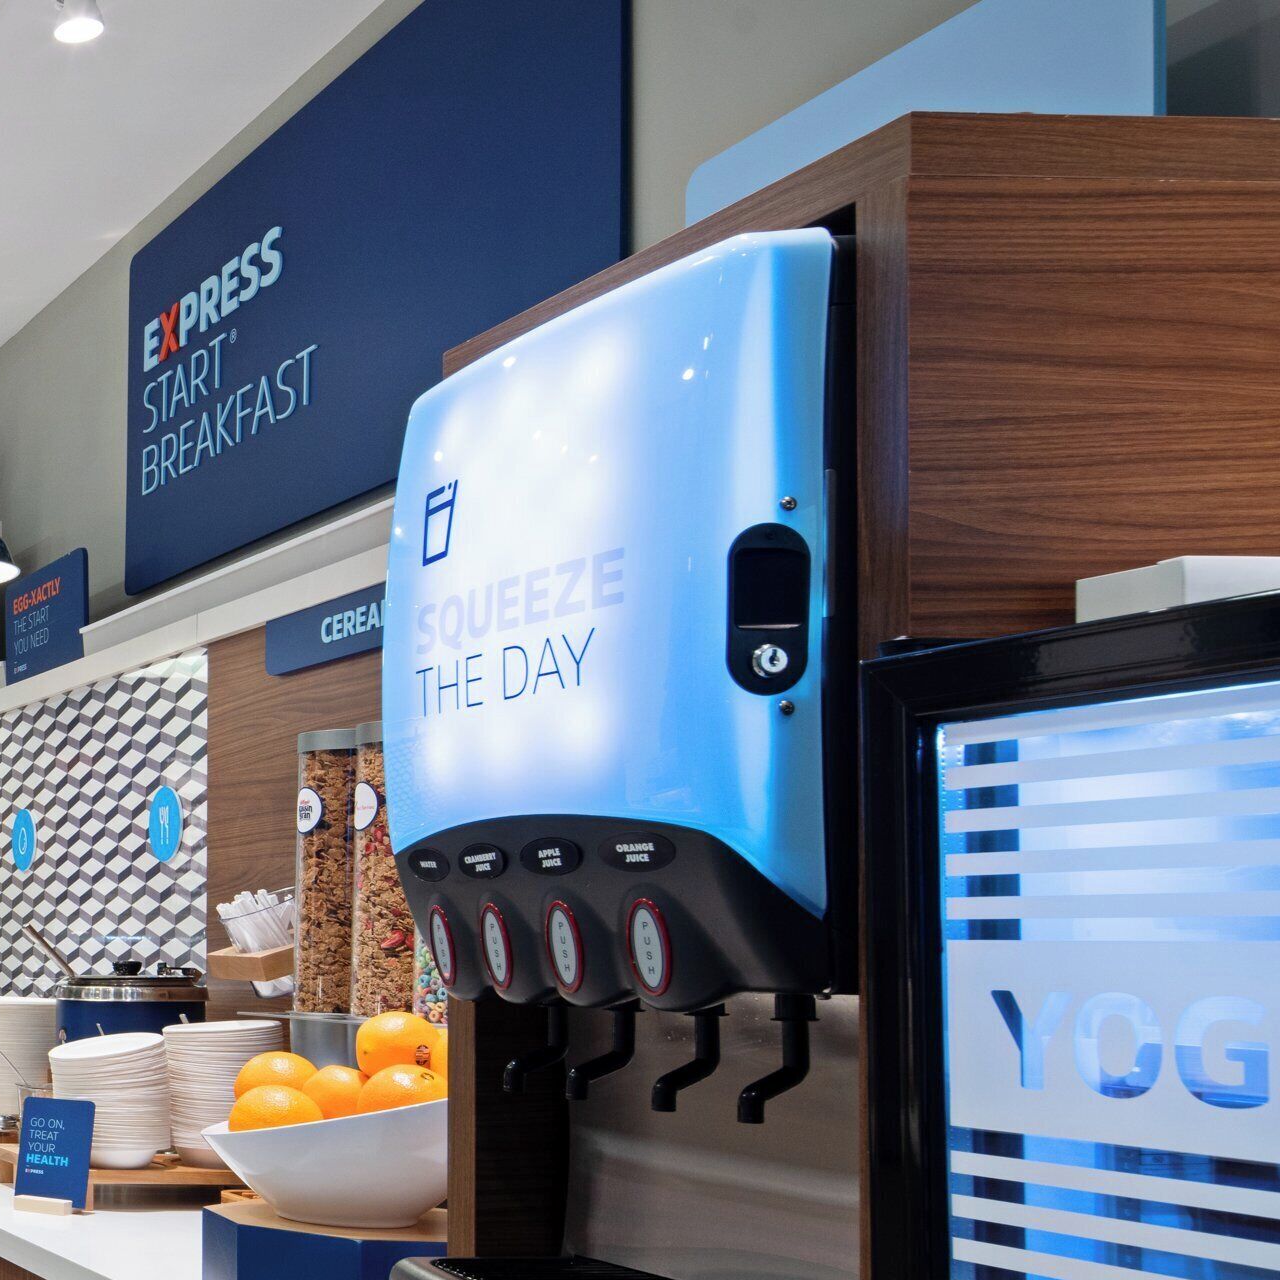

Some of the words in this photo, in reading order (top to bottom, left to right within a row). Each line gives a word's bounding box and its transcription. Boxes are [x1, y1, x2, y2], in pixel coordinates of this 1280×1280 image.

[143, 226, 283, 373] EXPRESS
[142, 344, 319, 496] BREAKFAST
[13, 577, 61, 615] EGG-XACTLY
[416, 547, 625, 655] SQUEEZE
[13, 616, 28, 635] THE
[28, 605, 50, 630] START
[13, 634, 29, 656] YOU
[30, 627, 50, 649] NEED
[415, 653, 484, 717] THE
[503, 627, 595, 700] DAY
[464, 852, 497, 864] CRANBERRY
[538, 847, 561, 859] APPLE
[615, 842, 655, 853] ORANGE
[625, 852, 650, 863] JUICE
[419, 860, 437, 869] WATER
[475, 862, 491, 872] JUICE
[542, 858, 562, 868] JUICE
[490, 923, 502, 971] PUSH
[558, 921, 571, 973] PUSH
[642, 921, 656, 975] PUSH
[990, 989, 1271, 1110] YOG
[30, 1117, 46, 1128] GO
[48, 1118, 65, 1131] ON,
[29, 1129, 60, 1141] TREAT
[27, 1142, 56, 1153] YOUR
[26, 1153, 69, 1167] HEALTH
